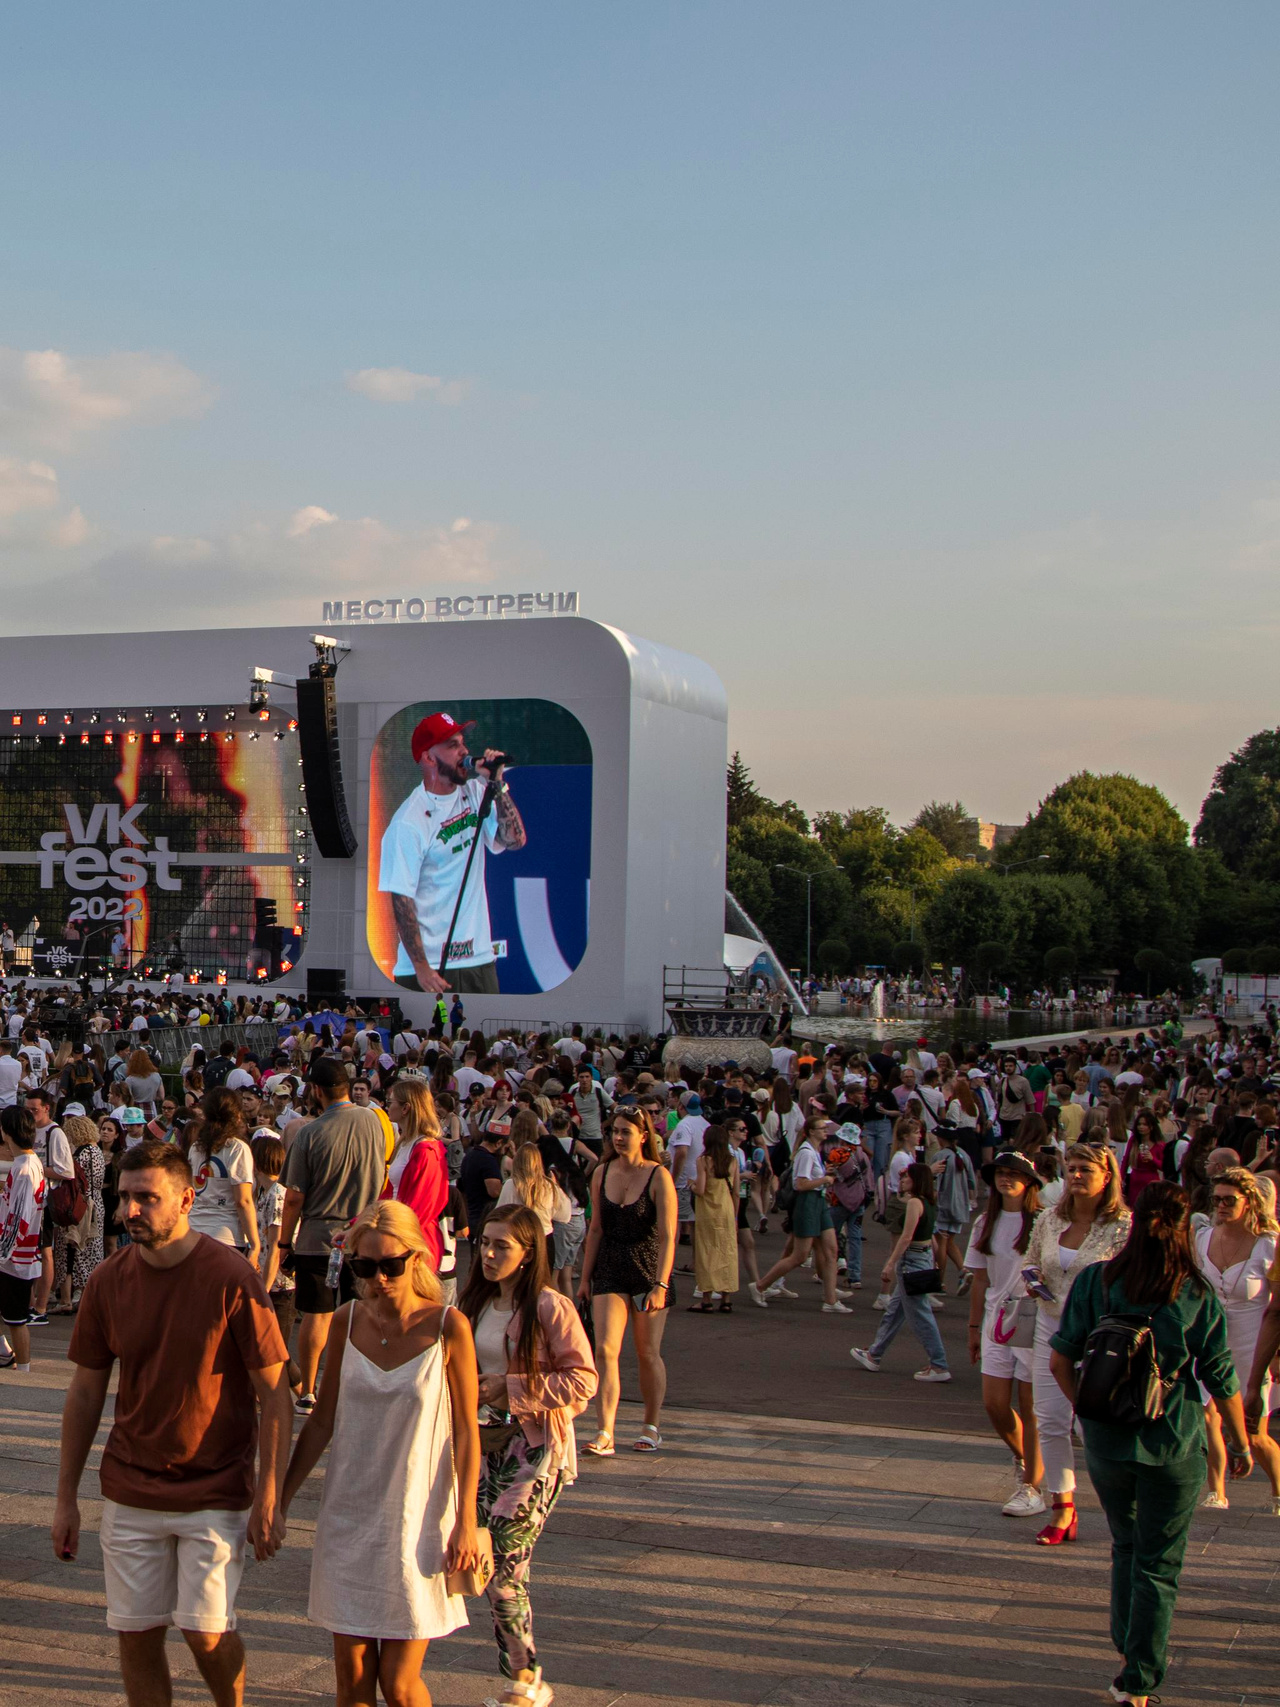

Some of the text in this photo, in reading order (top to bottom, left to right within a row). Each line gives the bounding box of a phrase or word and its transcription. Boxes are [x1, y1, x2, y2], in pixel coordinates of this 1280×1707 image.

[322, 591, 579, 621] МЕСТО ВСТРЕЧИ
[63, 803, 150, 845] VK
[36, 832, 182, 891] fest
[70, 897, 143, 921] 2022
[46, 951, 74, 964] fest
[51, 946, 68, 955] VK
